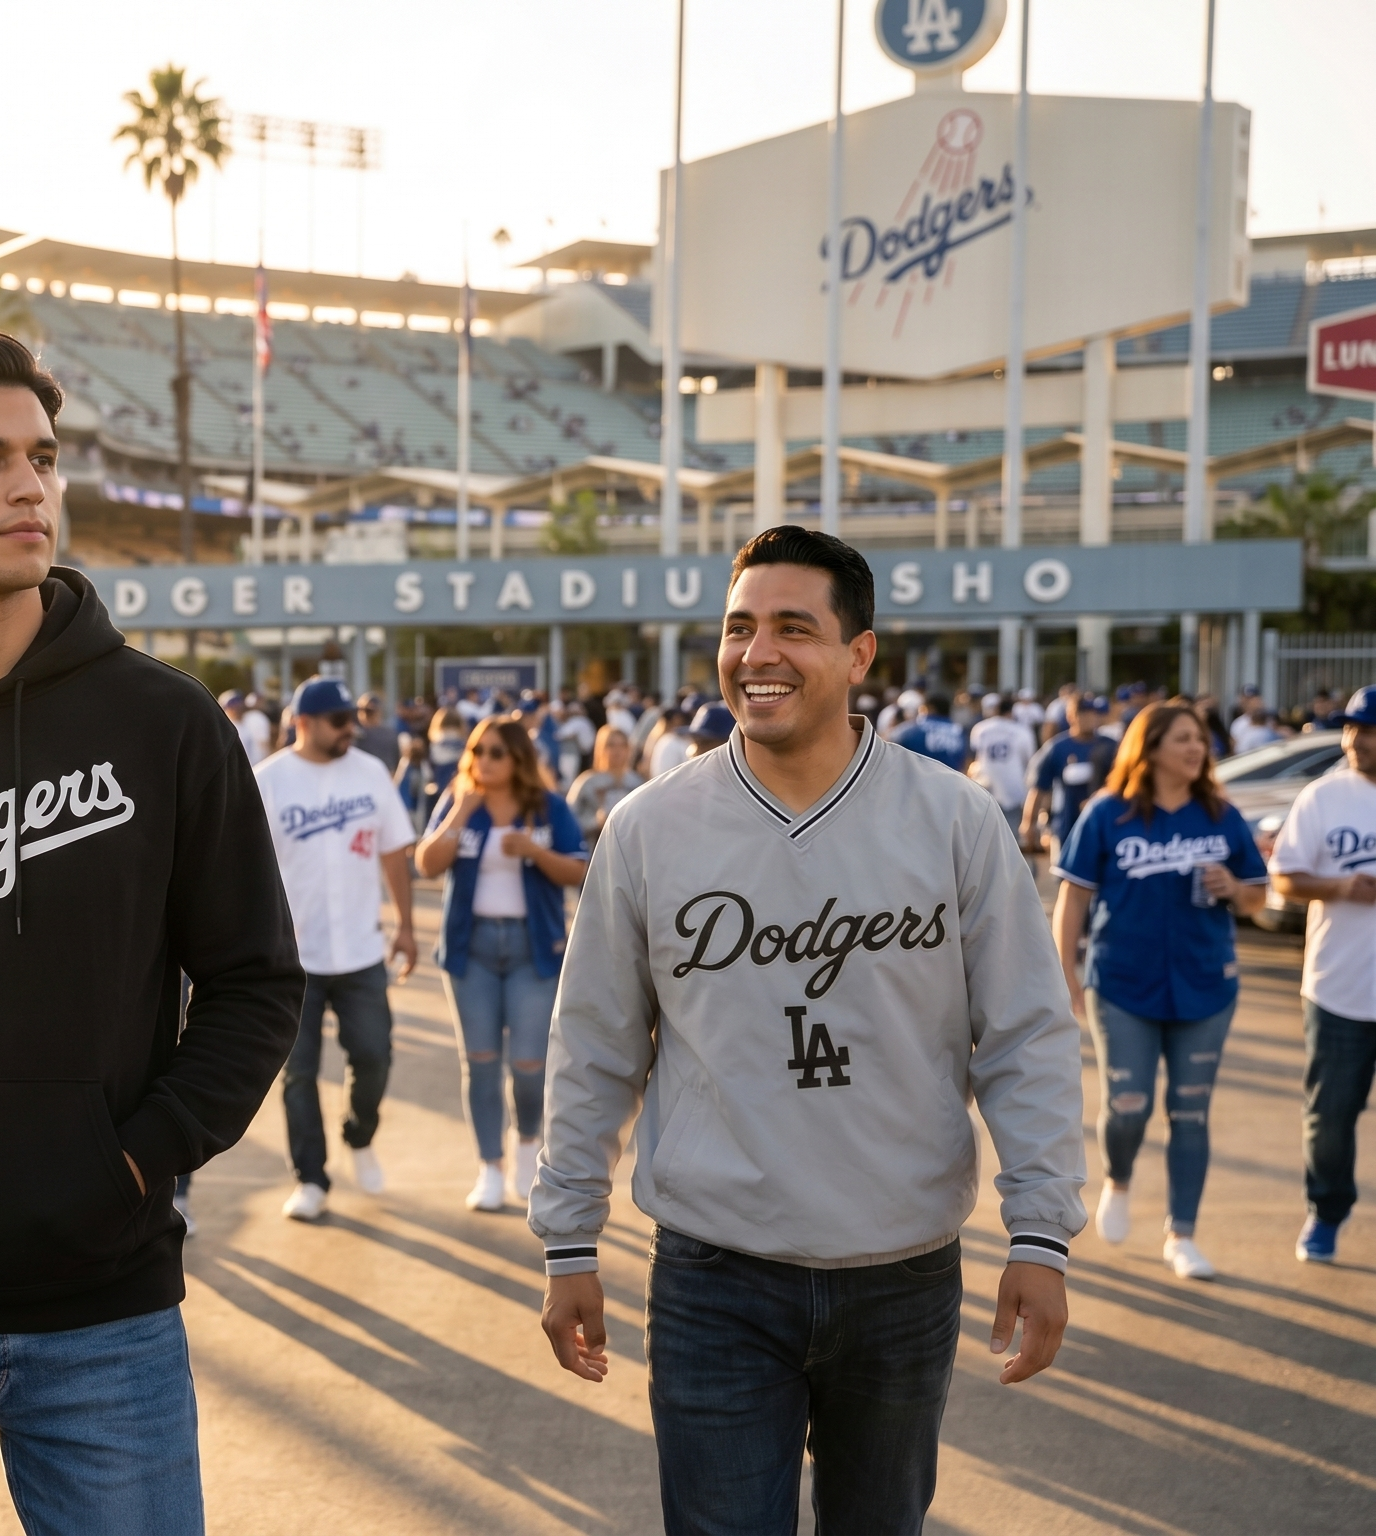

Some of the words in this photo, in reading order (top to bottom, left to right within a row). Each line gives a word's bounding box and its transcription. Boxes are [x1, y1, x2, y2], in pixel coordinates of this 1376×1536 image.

[902, 0, 962, 54] LA
[819, 162, 1034, 294] Dodgers
[890, 558, 1072, 605] SHO
[672, 890, 947, 1000] Dodgers
[784, 1005, 852, 1089] LA
